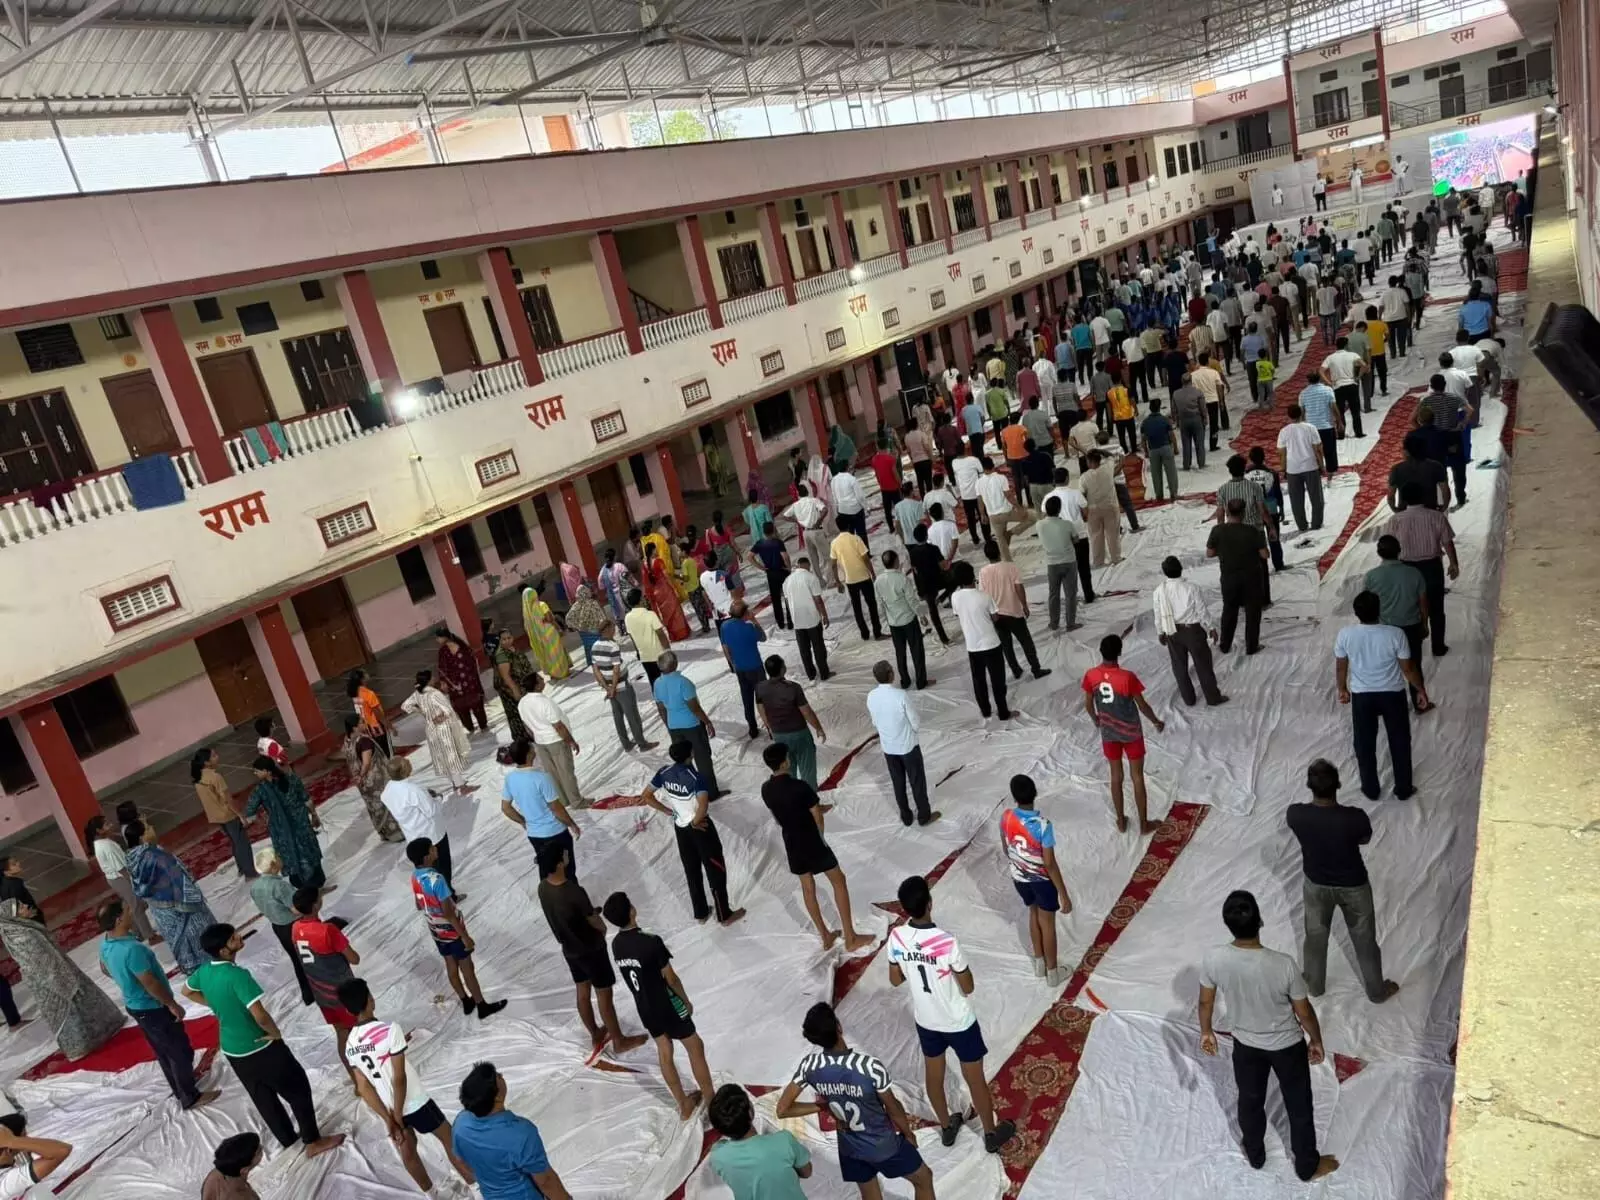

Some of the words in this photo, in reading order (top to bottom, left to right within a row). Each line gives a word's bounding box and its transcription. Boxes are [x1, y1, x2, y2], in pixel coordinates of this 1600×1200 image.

[1449, 27, 1476, 44] राम
[1319, 43, 1342, 59] राम
[1227, 89, 1249, 104] राम
[1327, 125, 1350, 140] राम
[947, 262, 962, 282] राम
[848, 294, 867, 318] राम
[710, 338, 738, 367] राम
[524, 394, 566, 430] राम
[199, 490, 270, 540] राम
[1099, 682, 1114, 704] 9
[665, 781, 689, 794] INDIA
[296, 940, 315, 963] 5
[902, 951, 937, 965] LAKHAN
[630, 970, 640, 992] 6
[917, 965, 932, 993] 1
[816, 1083, 863, 1098] SHAHPURA
